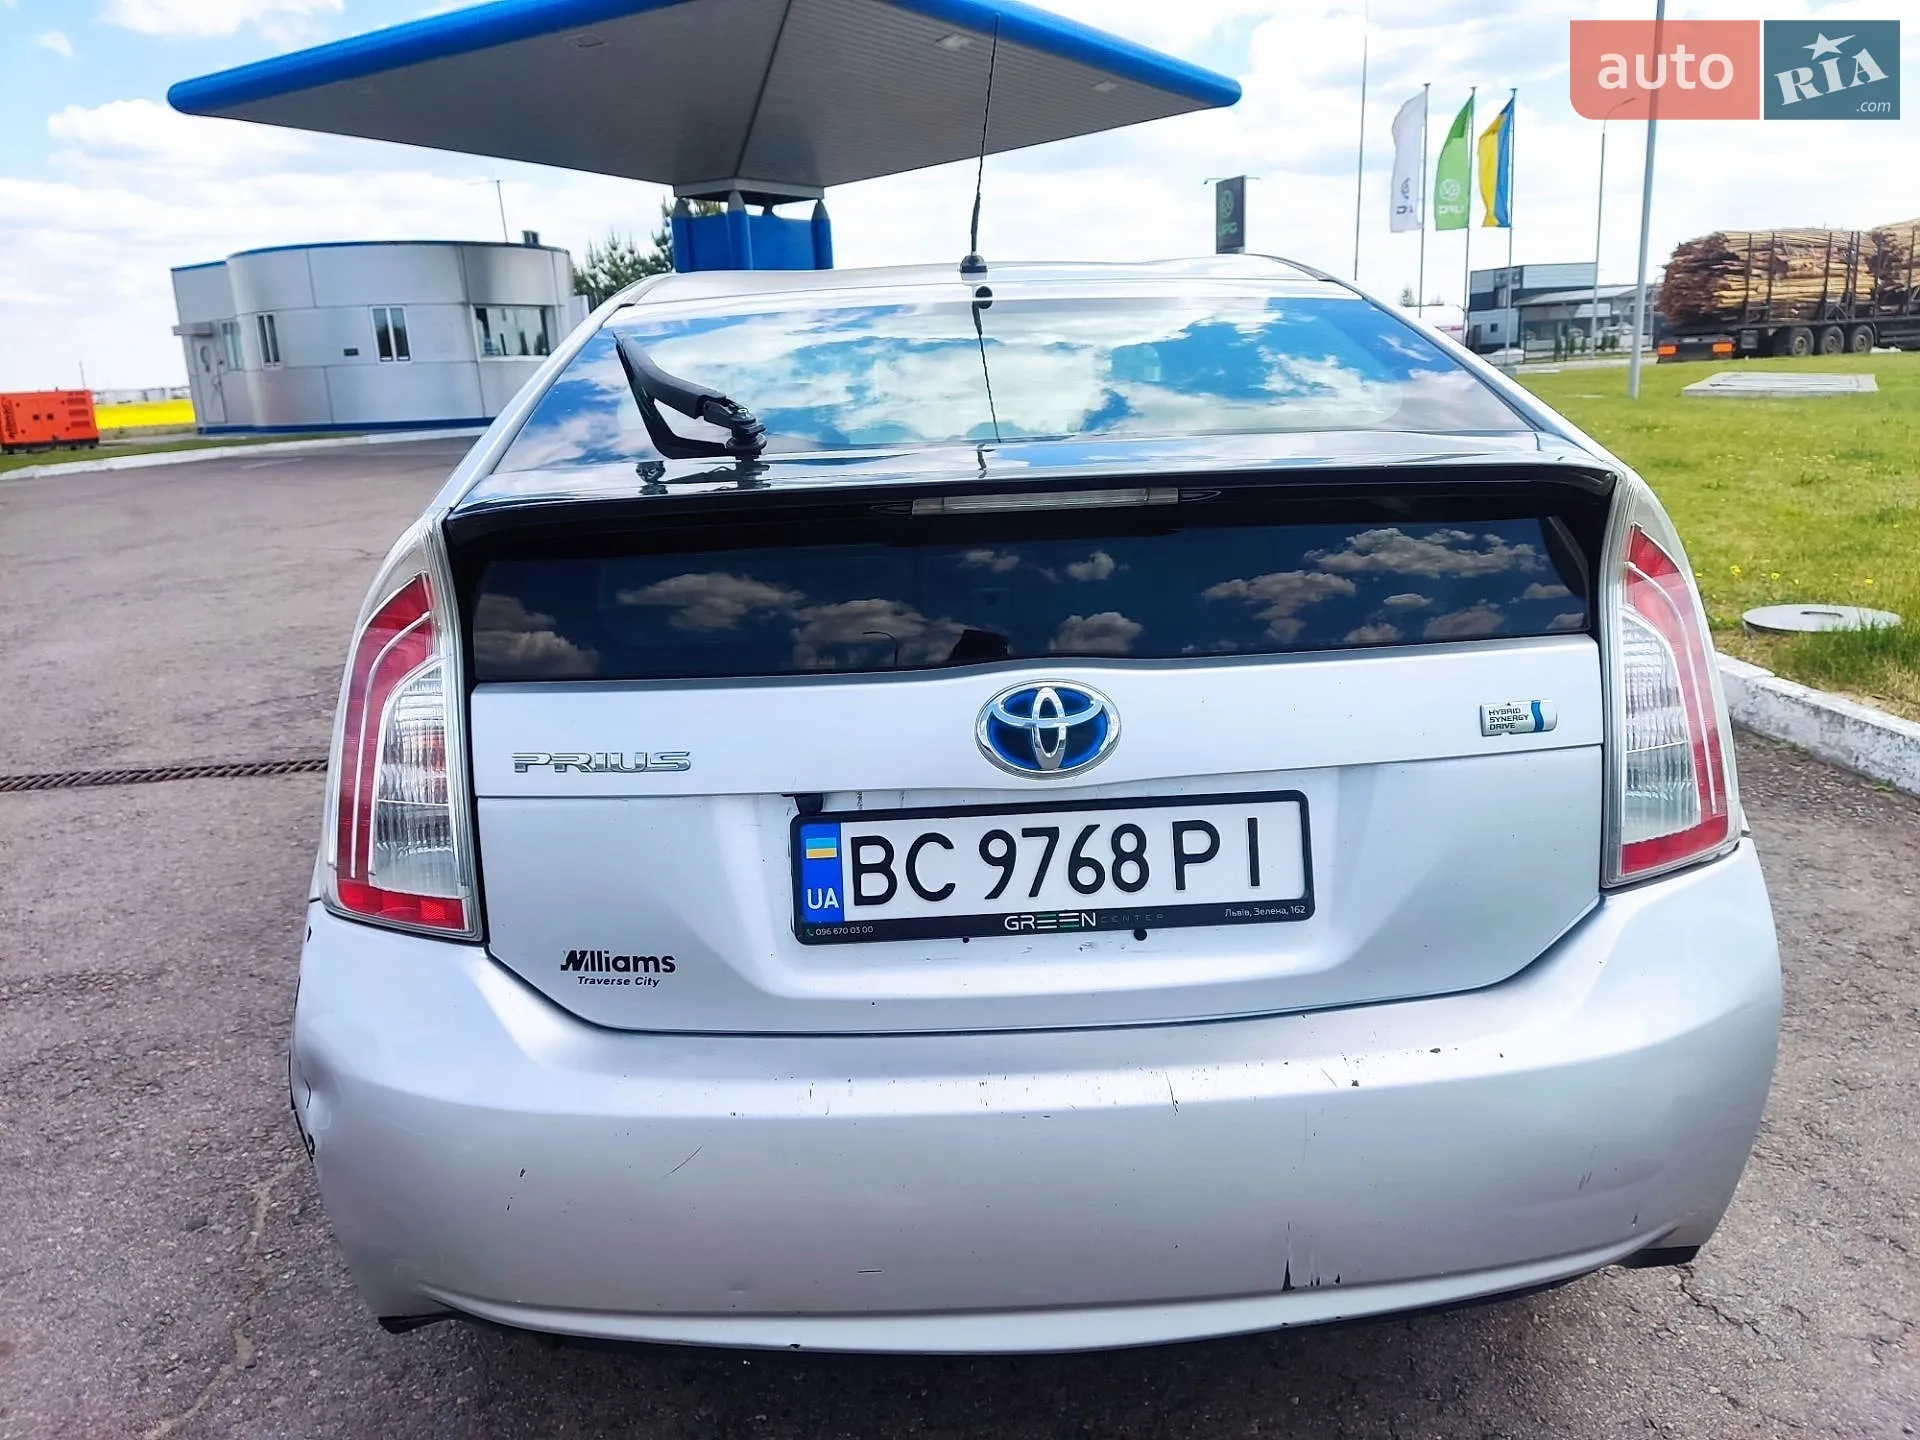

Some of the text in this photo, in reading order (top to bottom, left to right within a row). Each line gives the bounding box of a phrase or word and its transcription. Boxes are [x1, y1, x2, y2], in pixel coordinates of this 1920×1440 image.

[1488, 707, 1521, 716] HYBRID
[1489, 714, 1529, 723] SYNERGY
[1489, 722, 1516, 730] DRIVE
[512, 750, 691, 773] PRIUS
[850, 832, 956, 906] BC
[979, 823, 1150, 900] 9768
[807, 887, 839, 909] UA
[1225, 908, 1252, 917] Львів,
[1291, 905, 1306, 914] 162
[1004, 912, 1164, 931] GREEN CENTER
[815, 925, 874, 936] 096 670 03 00
[577, 976, 660, 988] Traverse City
